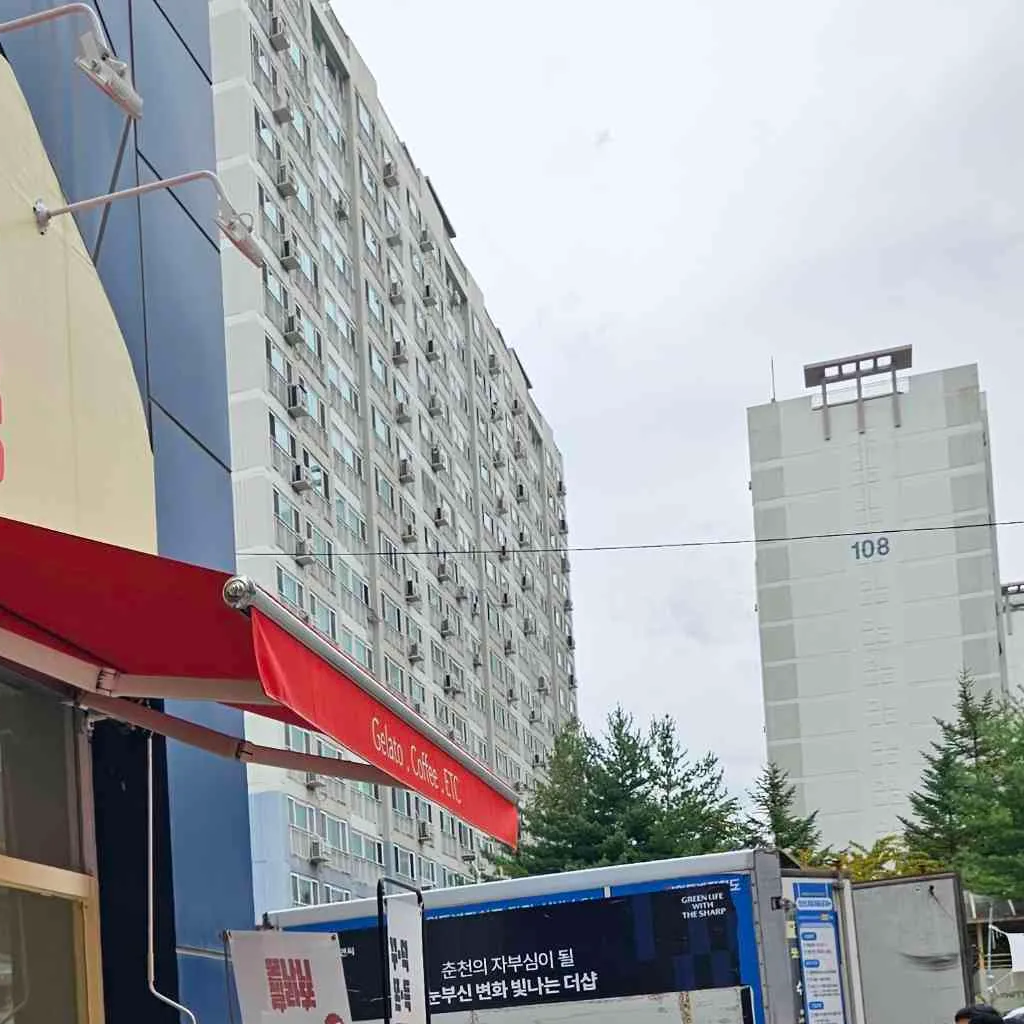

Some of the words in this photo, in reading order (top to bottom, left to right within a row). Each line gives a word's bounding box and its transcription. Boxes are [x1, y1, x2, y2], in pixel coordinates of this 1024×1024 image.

[851, 537, 890, 560] 108
[681, 894, 707, 904] GREEN
[708, 892, 724, 901] LIFE
[692, 901, 714, 910] WITH
[682, 911, 697, 919] THE
[698, 907, 727, 918] SHARP
[441, 957, 488, 980] 춘천의
[491, 950, 554, 975] 자부심이
[558, 948, 575, 968] 될
[476, 979, 509, 1001] 변화
[510, 975, 561, 998] 빛나는
[563, 970, 598, 993] 더샵
